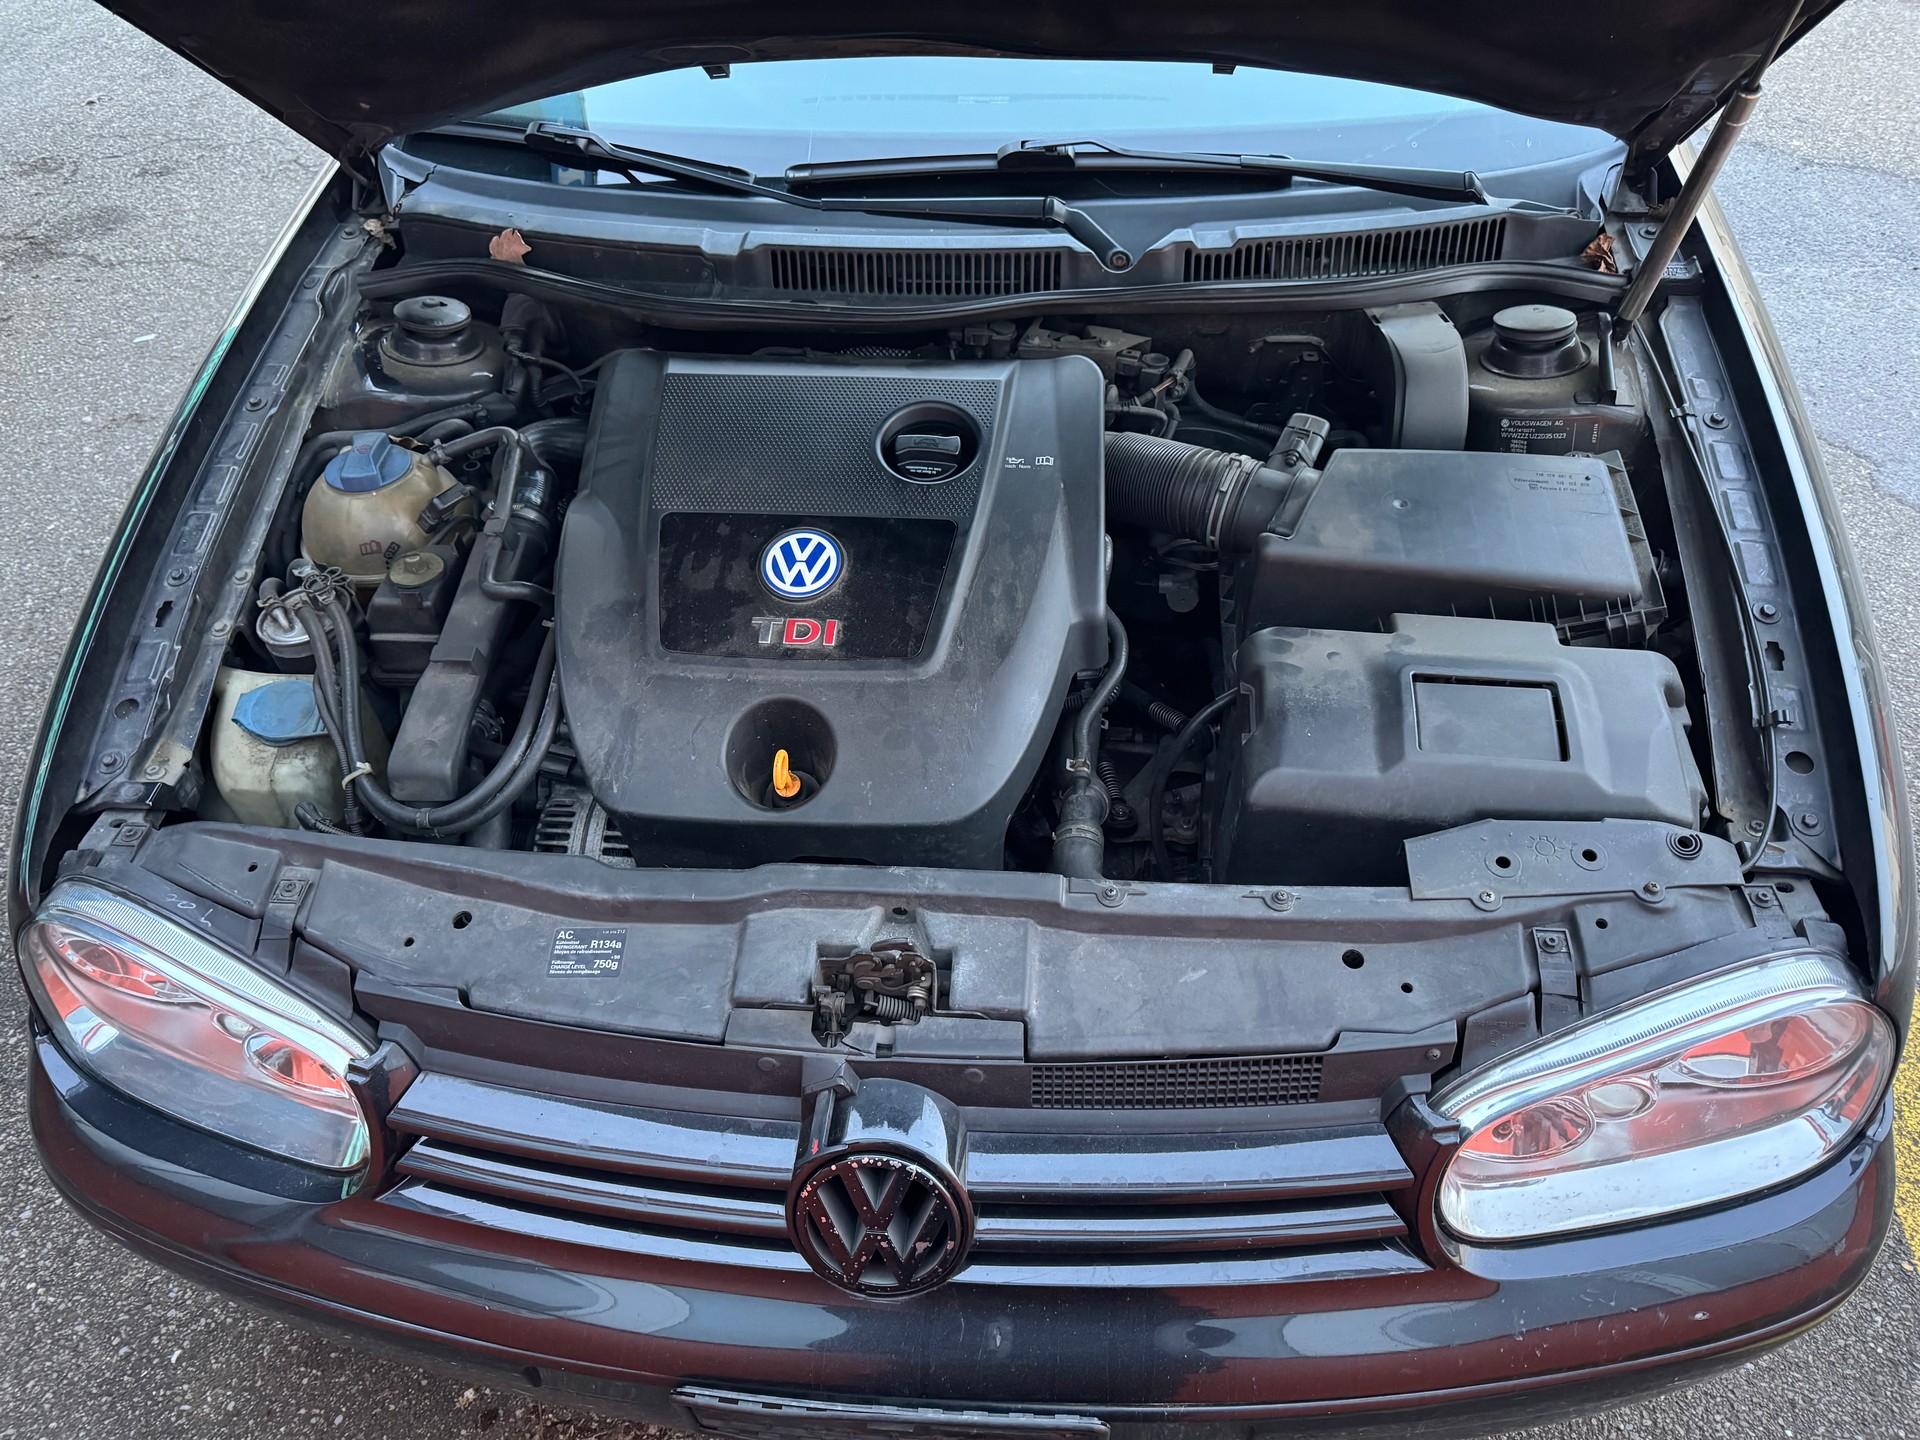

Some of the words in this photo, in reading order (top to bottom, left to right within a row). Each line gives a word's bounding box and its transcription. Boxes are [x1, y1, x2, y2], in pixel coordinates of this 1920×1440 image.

[761, 529, 841, 598] VW
[752, 617, 838, 646] TDI
[557, 930, 574, 940] AC
[590, 940, 622, 949] R134a
[593, 960, 619, 970] 750g
